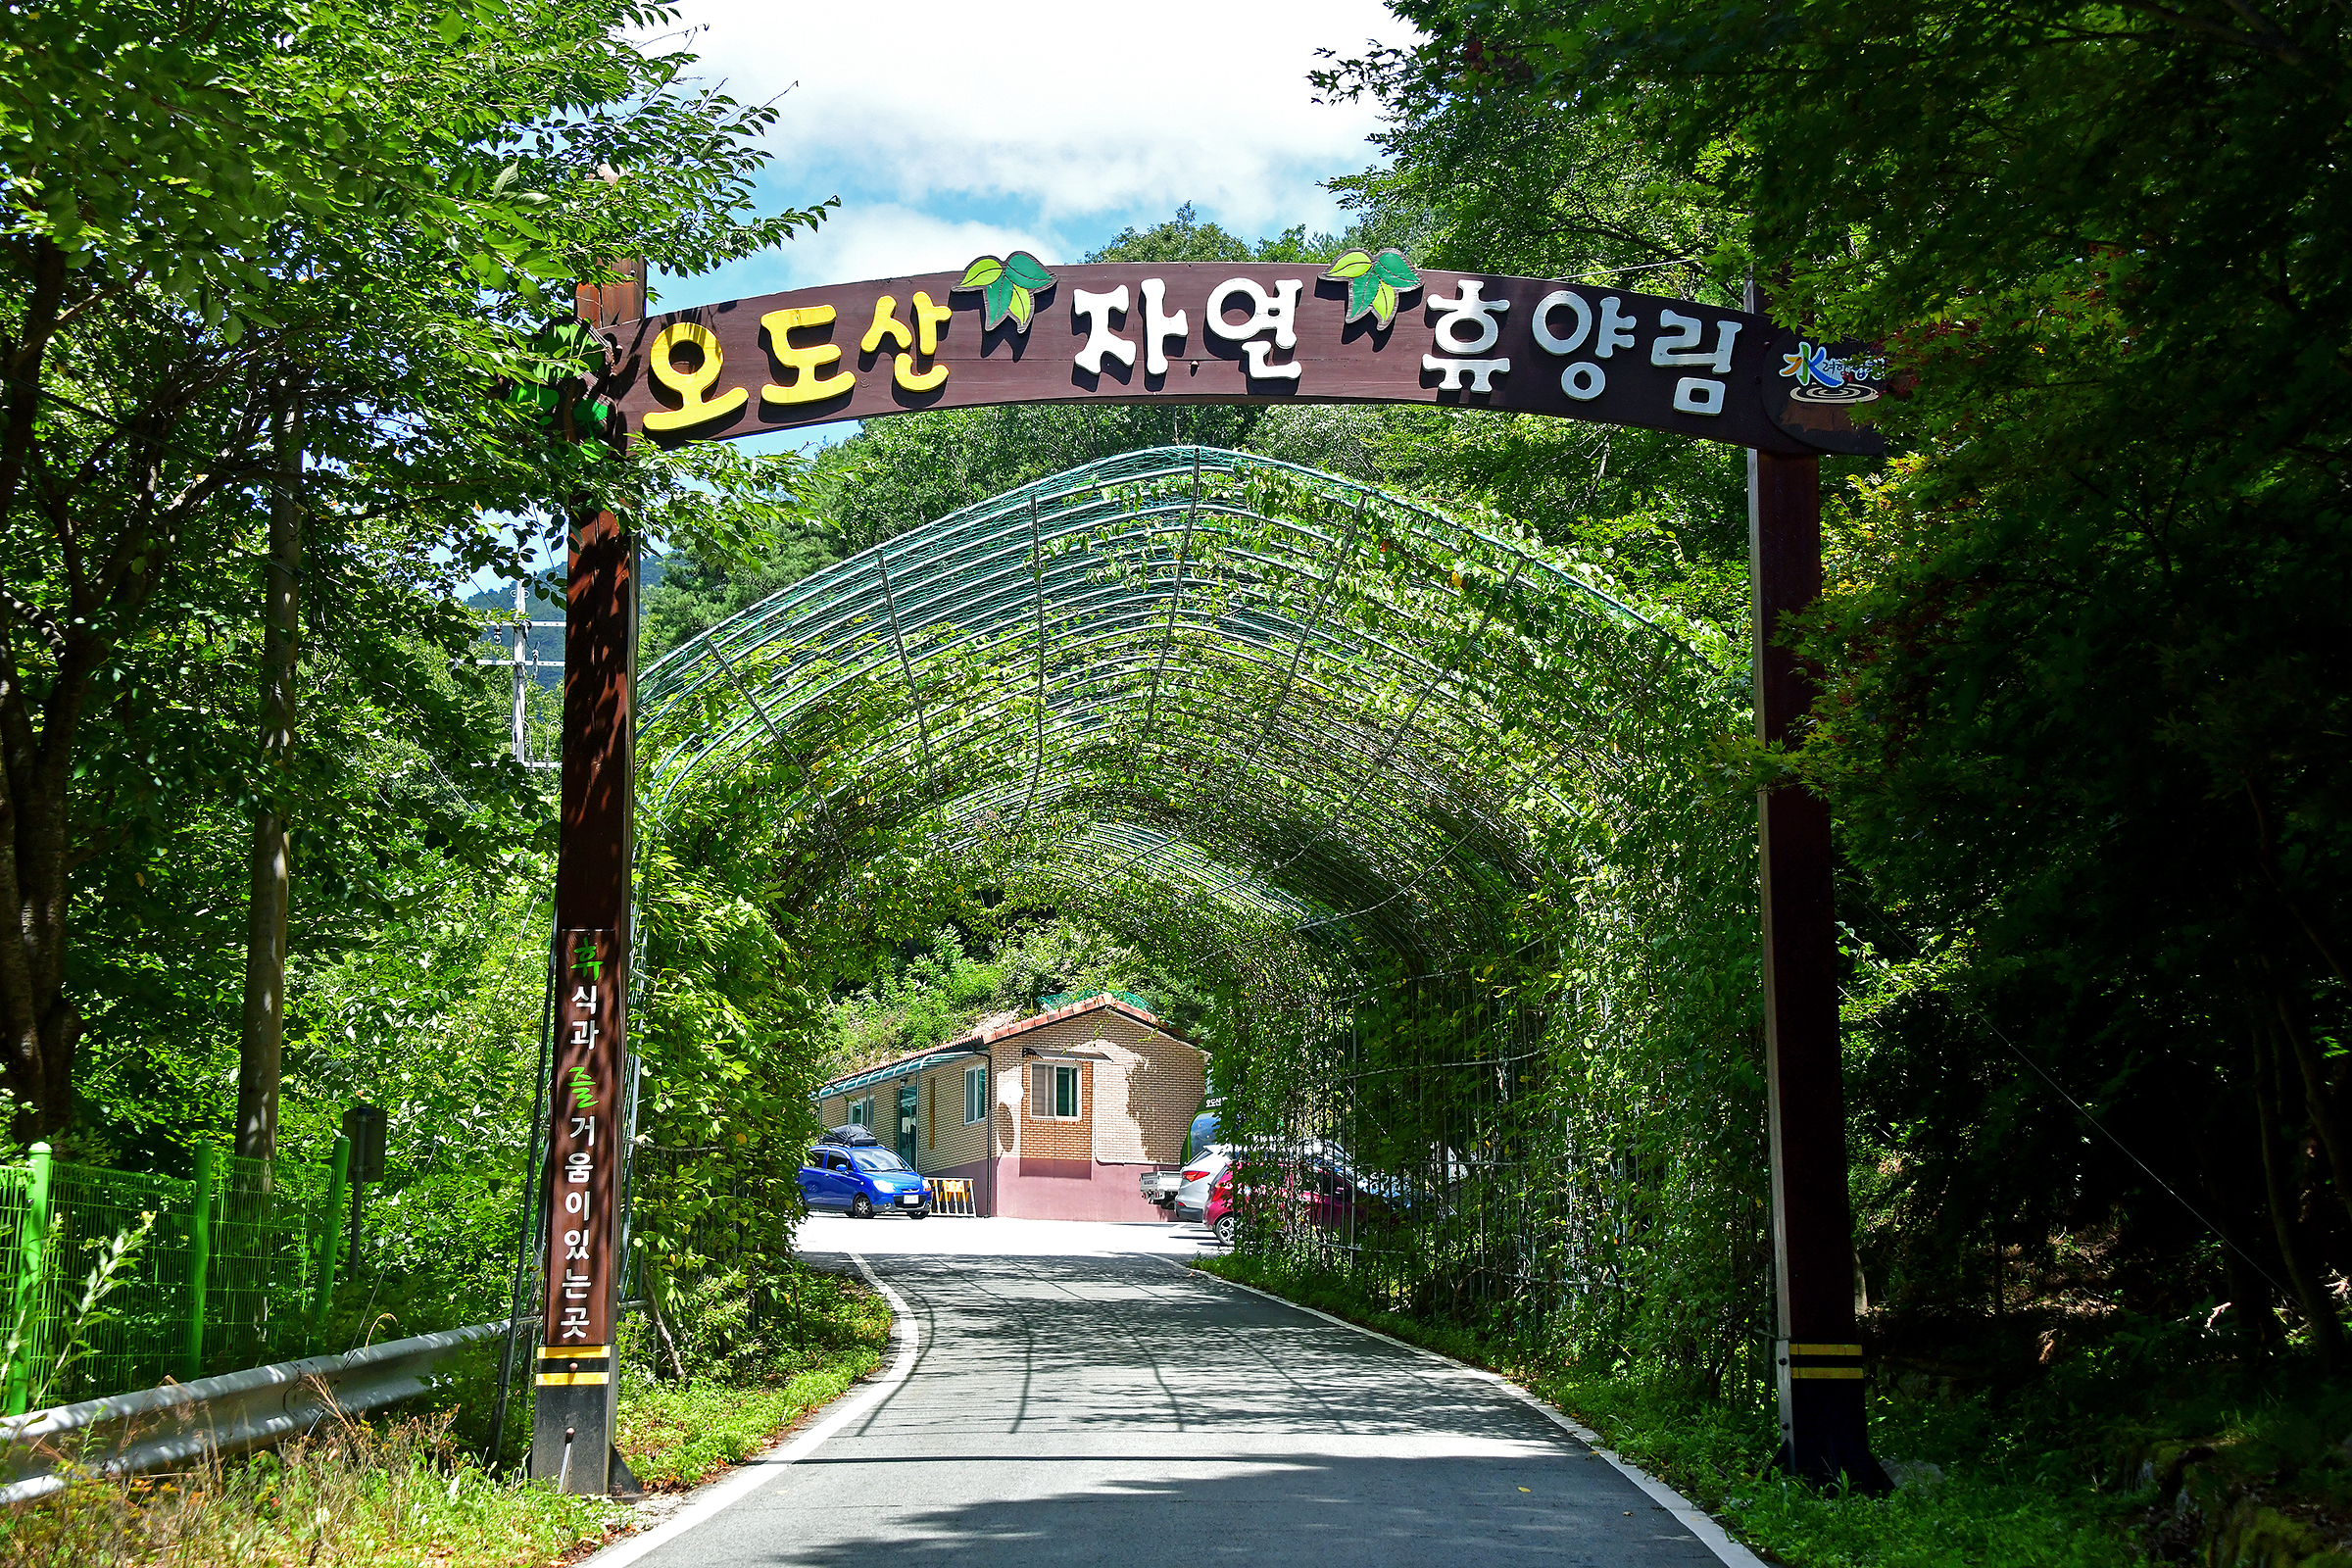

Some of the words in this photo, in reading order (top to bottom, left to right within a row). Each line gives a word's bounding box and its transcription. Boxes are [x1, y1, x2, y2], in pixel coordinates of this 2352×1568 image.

[642, 290, 953, 432] 오도산
[1072, 277, 1303, 380] 자연
[1421, 279, 1742, 416] 휴양림
[570, 936, 603, 1051] 휴식과
